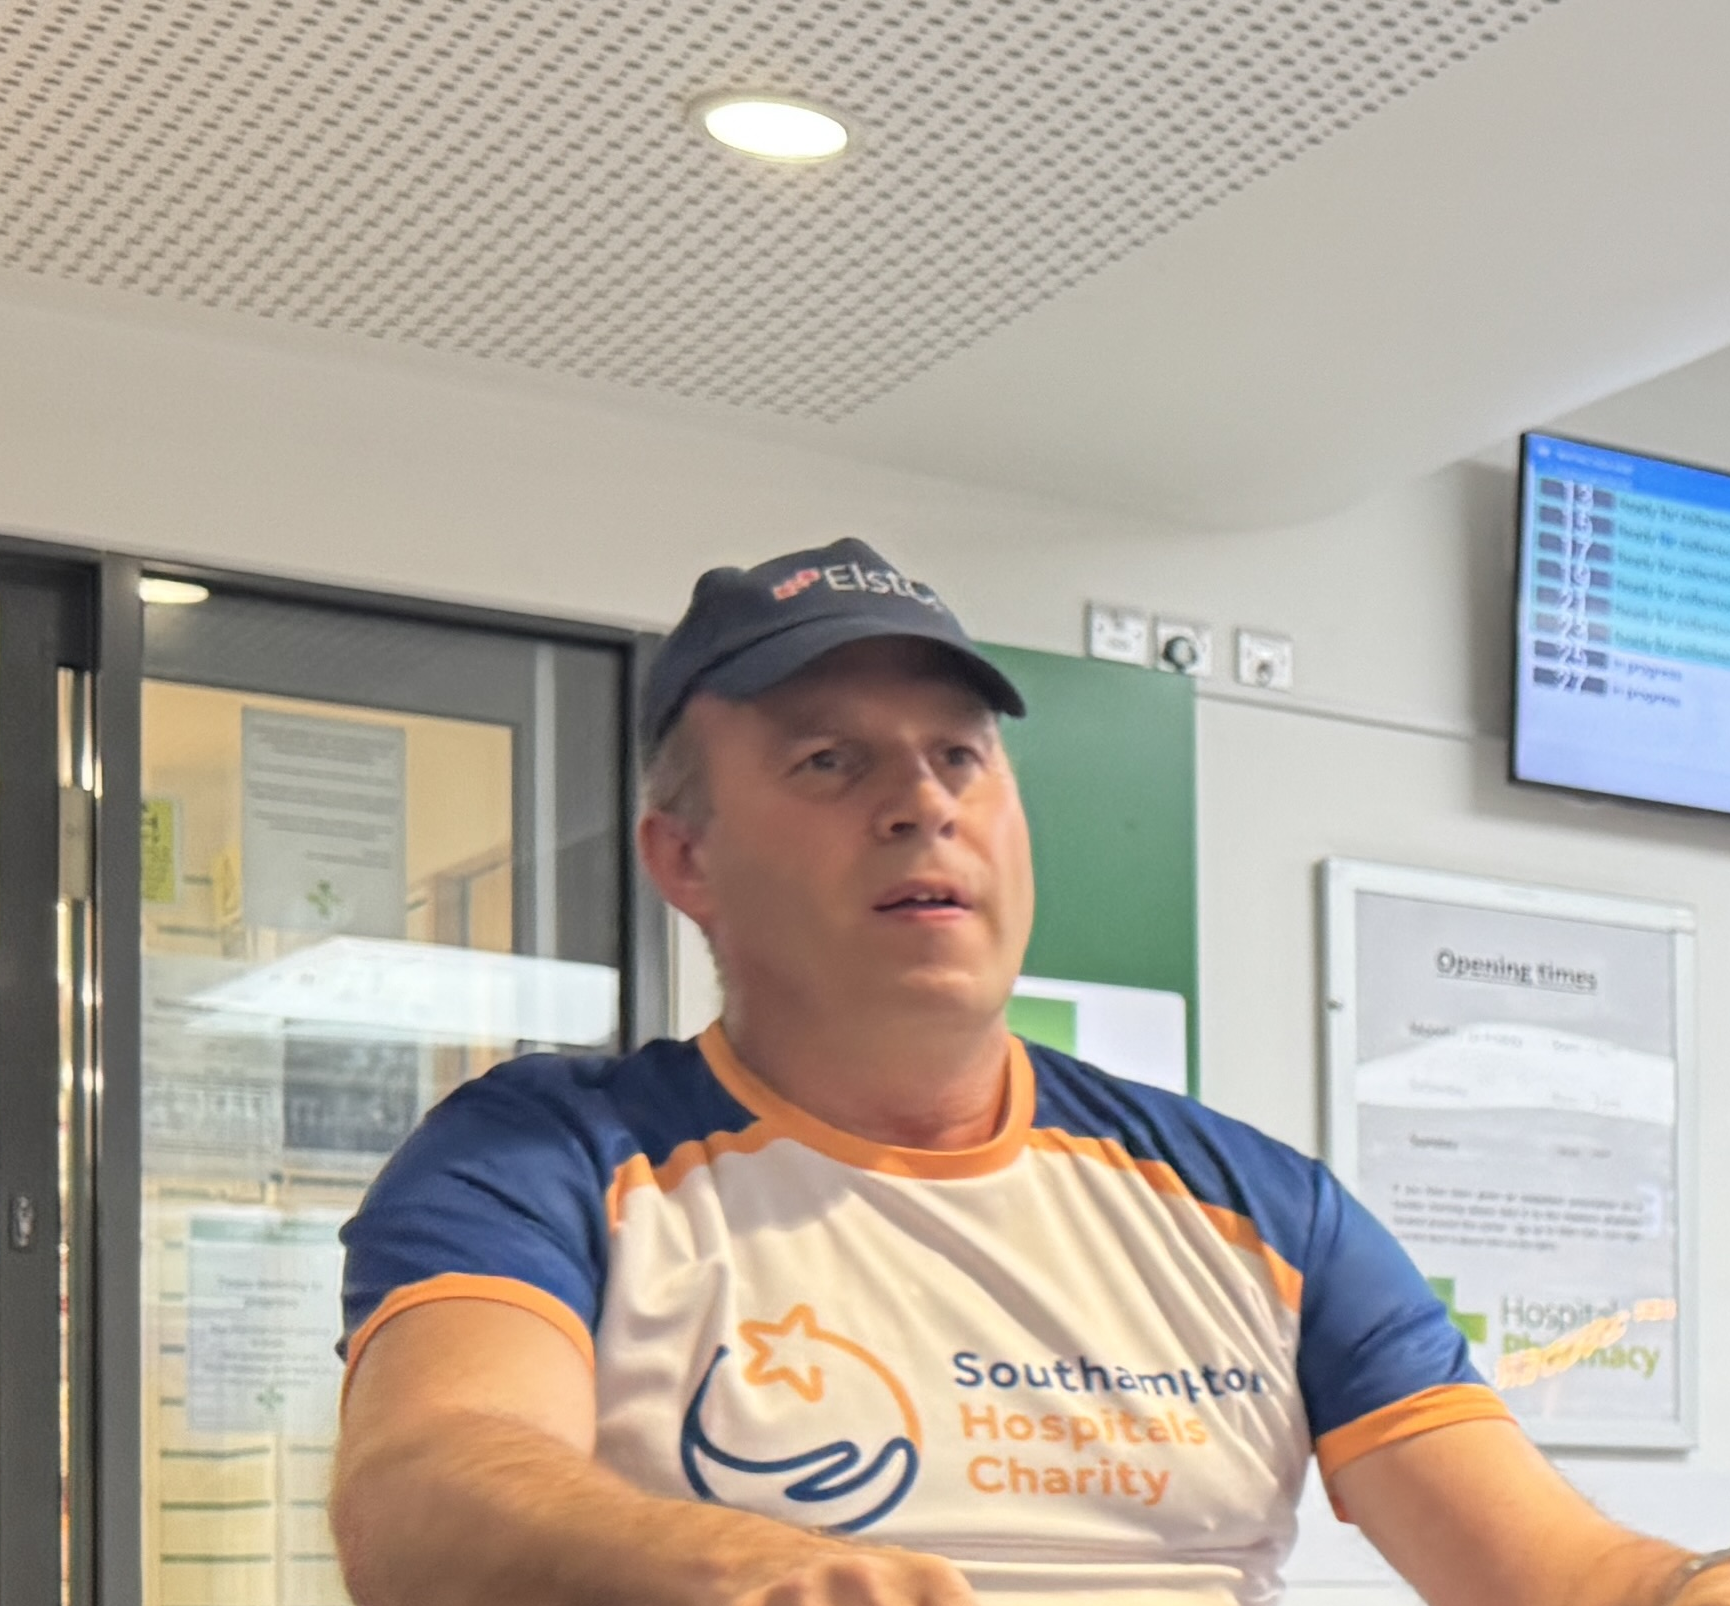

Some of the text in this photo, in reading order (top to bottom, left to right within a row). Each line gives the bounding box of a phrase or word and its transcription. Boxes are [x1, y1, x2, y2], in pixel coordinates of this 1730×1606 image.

[1436, 948, 1599, 992] Opening times
[960, 1401, 1208, 1452] Hospitals
[967, 1455, 1170, 1506] Charity
